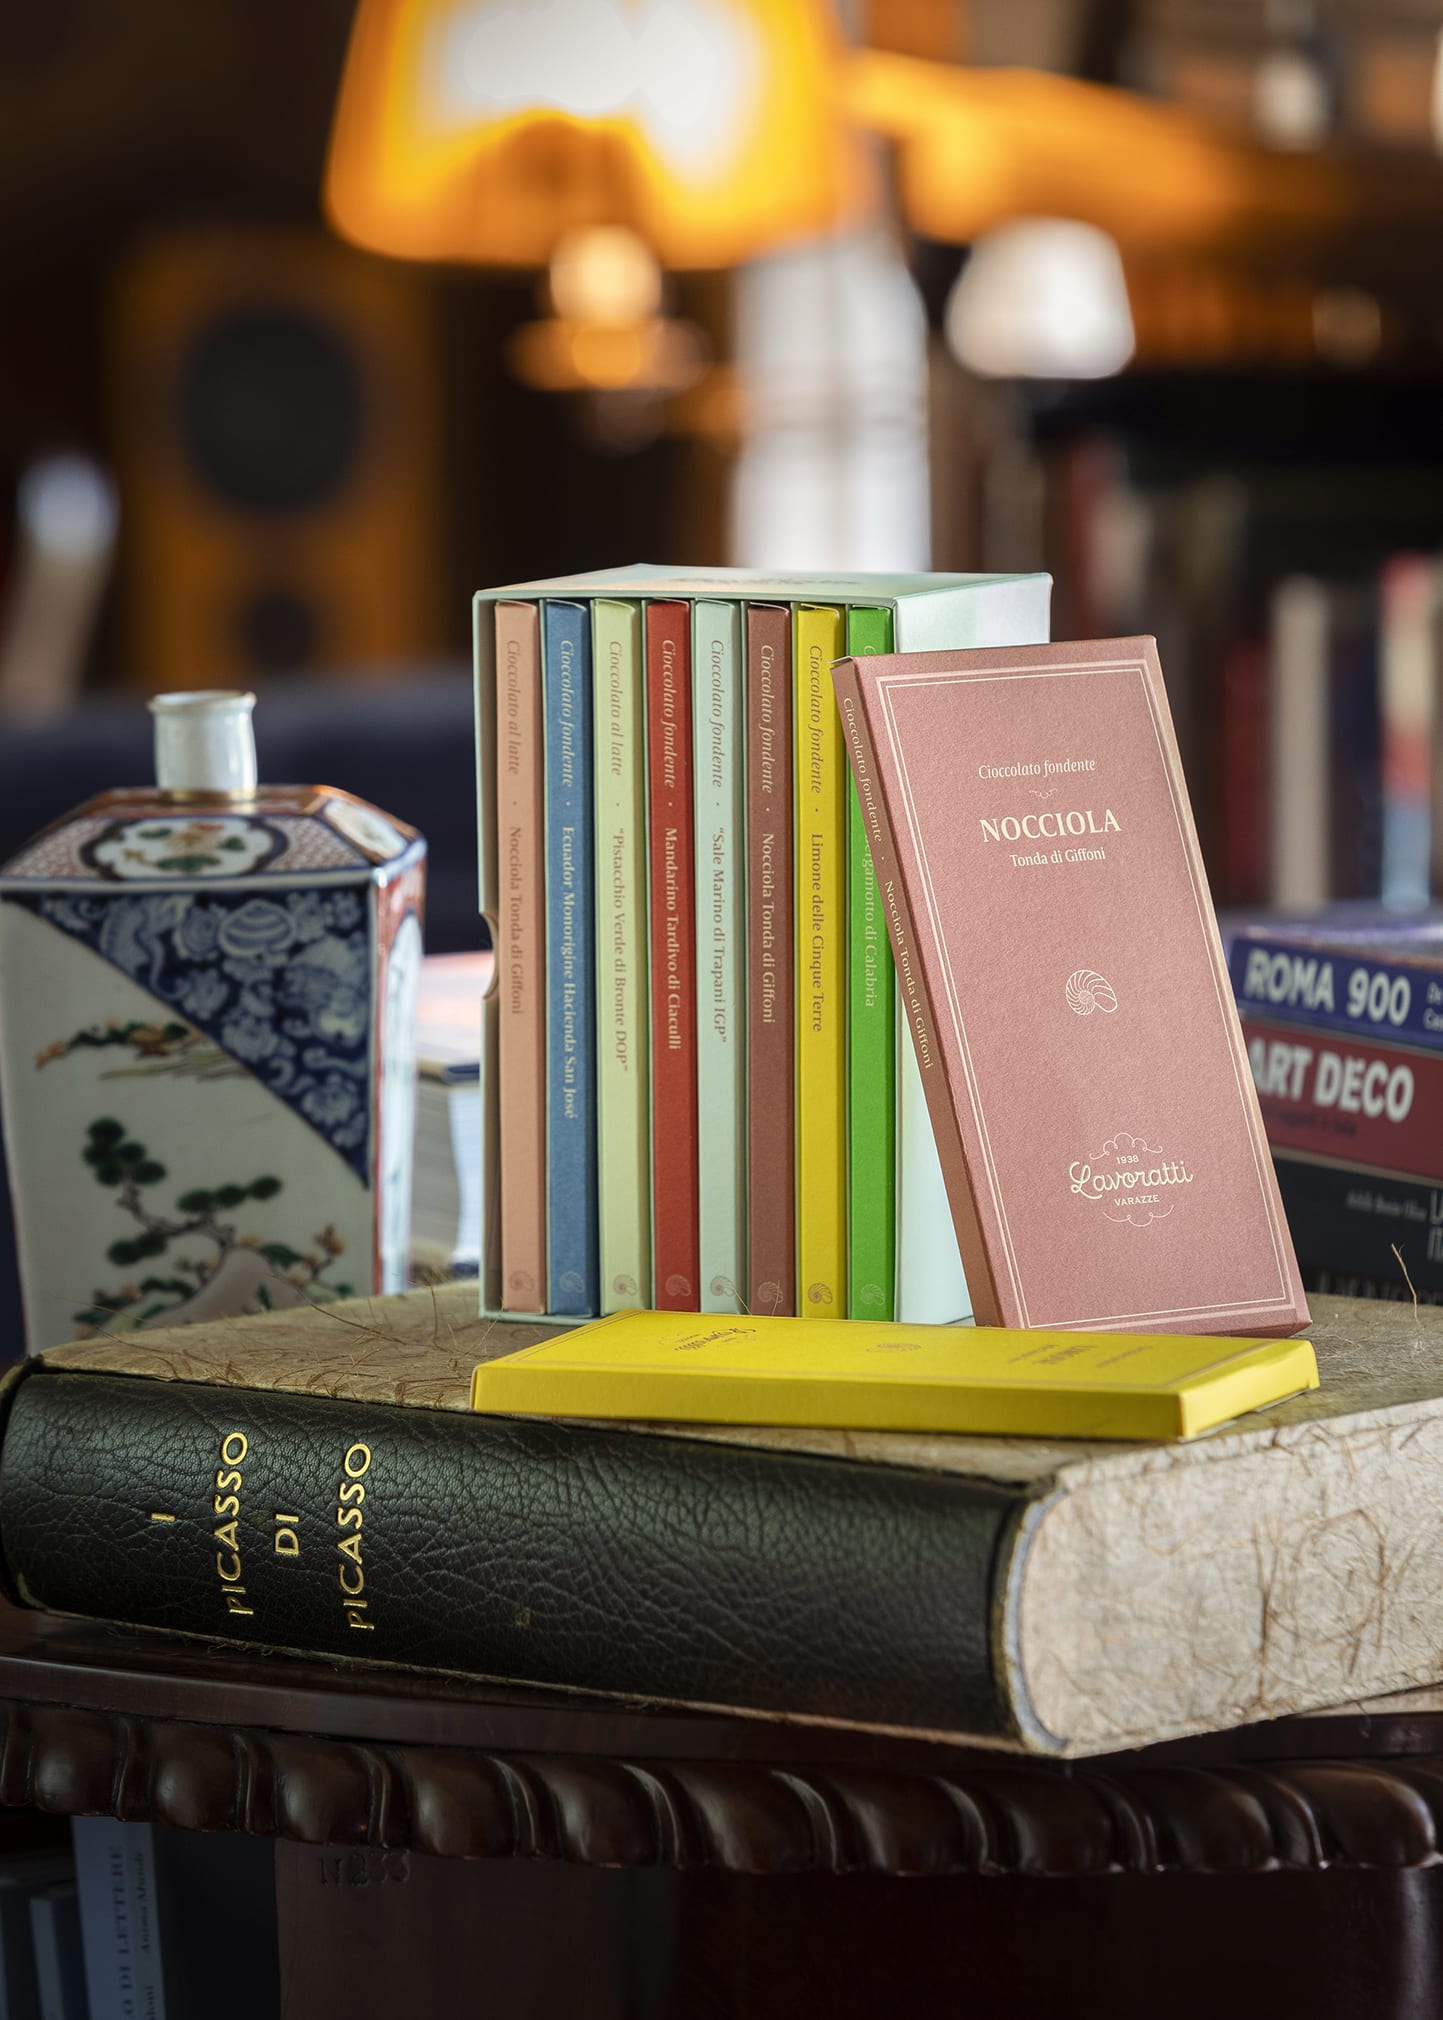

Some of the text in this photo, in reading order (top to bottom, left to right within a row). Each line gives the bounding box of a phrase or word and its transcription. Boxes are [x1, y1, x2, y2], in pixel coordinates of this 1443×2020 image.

[609, 641, 624, 718] Cioccolato
[708, 640, 726, 720] Cioccolato
[610, 723, 625, 737] al
[708, 719, 726, 787] fondente
[610, 742, 625, 775] latte
[978, 758, 1097, 780] Cioccolato fondente
[506, 640, 524, 1016] Cioccolato al latte Nocciola Tonda di Giffoni
[660, 640, 682, 1049] Cioccolato fondente Mandarino Tardivo di Ciaculli
[758, 645, 776, 1022] Cioccolato fondente Nocciola Tonda di Giffoni
[807, 646, 825, 1031] Cioccolato fondente Limone delle Cinque Terre
[979, 808, 1122, 843] NOCCIOLA
[558, 640, 578, 1118] Cioccolato fondente Ecuador Monorigine Hacienda San José
[843, 697, 934, 1069] Cioccolato fondente Nocciola Tonda di Giffoni
[1009, 847, 1106, 868] Tonda di Giffoni
[712, 870, 726, 923] Marino
[862, 835, 878, 1007] ergamotto di Calabria
[613, 913, 627, 954] Verde
[713, 928, 726, 941] di
[614, 958, 627, 972] di
[710, 947, 726, 1002] Trapani
[1245, 949, 1412, 1026] ROMA 900
[614, 978, 627, 1025] Bronte
[1250, 1036, 1313, 1102] ART
[1314, 1051, 1415, 1123] DECO
[1069, 1160, 1194, 1200] Lavoratti
[1116, 1154, 1139, 1164] 1938
[1113, 1194, 1160, 1206] VARAZZE
[151, 1512, 176, 1523] I
[213, 1431, 254, 1616] PICASSO
[274, 1513, 300, 1556] DI
[337, 1442, 375, 1631] PICASSO
